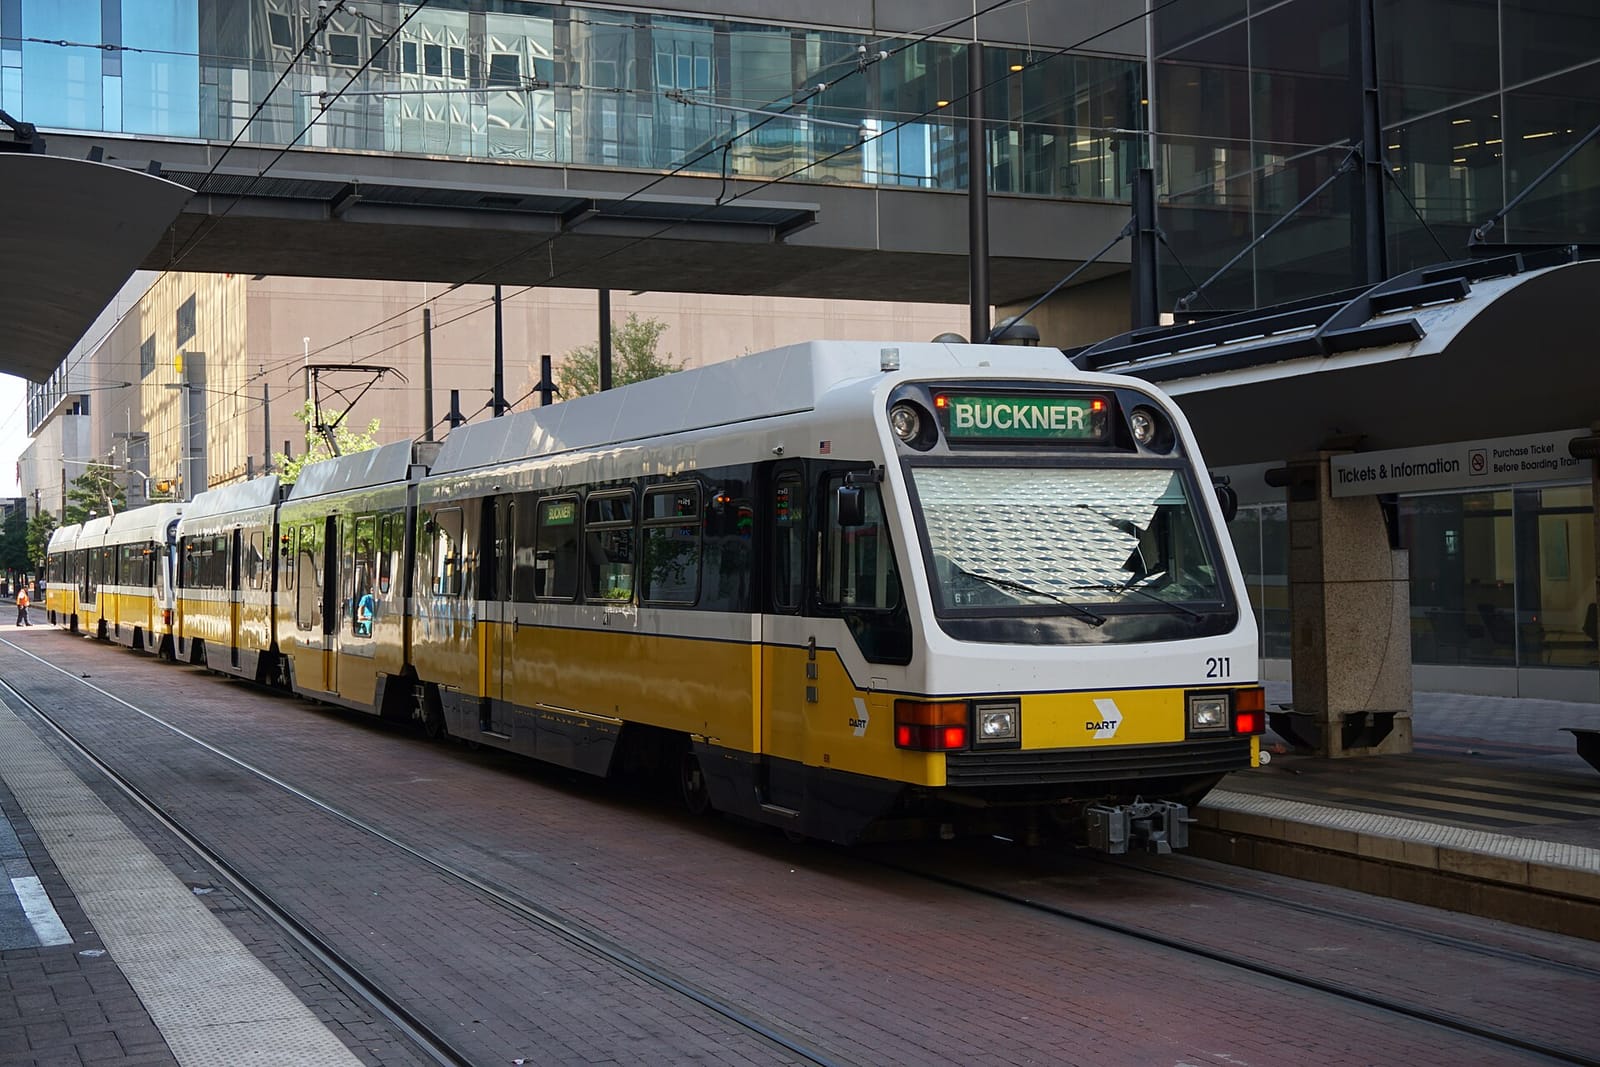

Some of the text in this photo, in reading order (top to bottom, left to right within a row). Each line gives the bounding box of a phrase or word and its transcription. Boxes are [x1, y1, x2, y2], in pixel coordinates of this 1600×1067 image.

[956, 403, 1084, 430] BUCKNER
[1493, 444, 1554, 459] Purchase Ticket
[1338, 458, 1460, 484] Tickets & Information
[1494, 463, 1519, 473] Before
[1521, 458, 1558, 471] Boarding
[1206, 657, 1231, 678] 211
[848, 718, 867, 729] DART
[1085, 720, 1117, 731] DART
